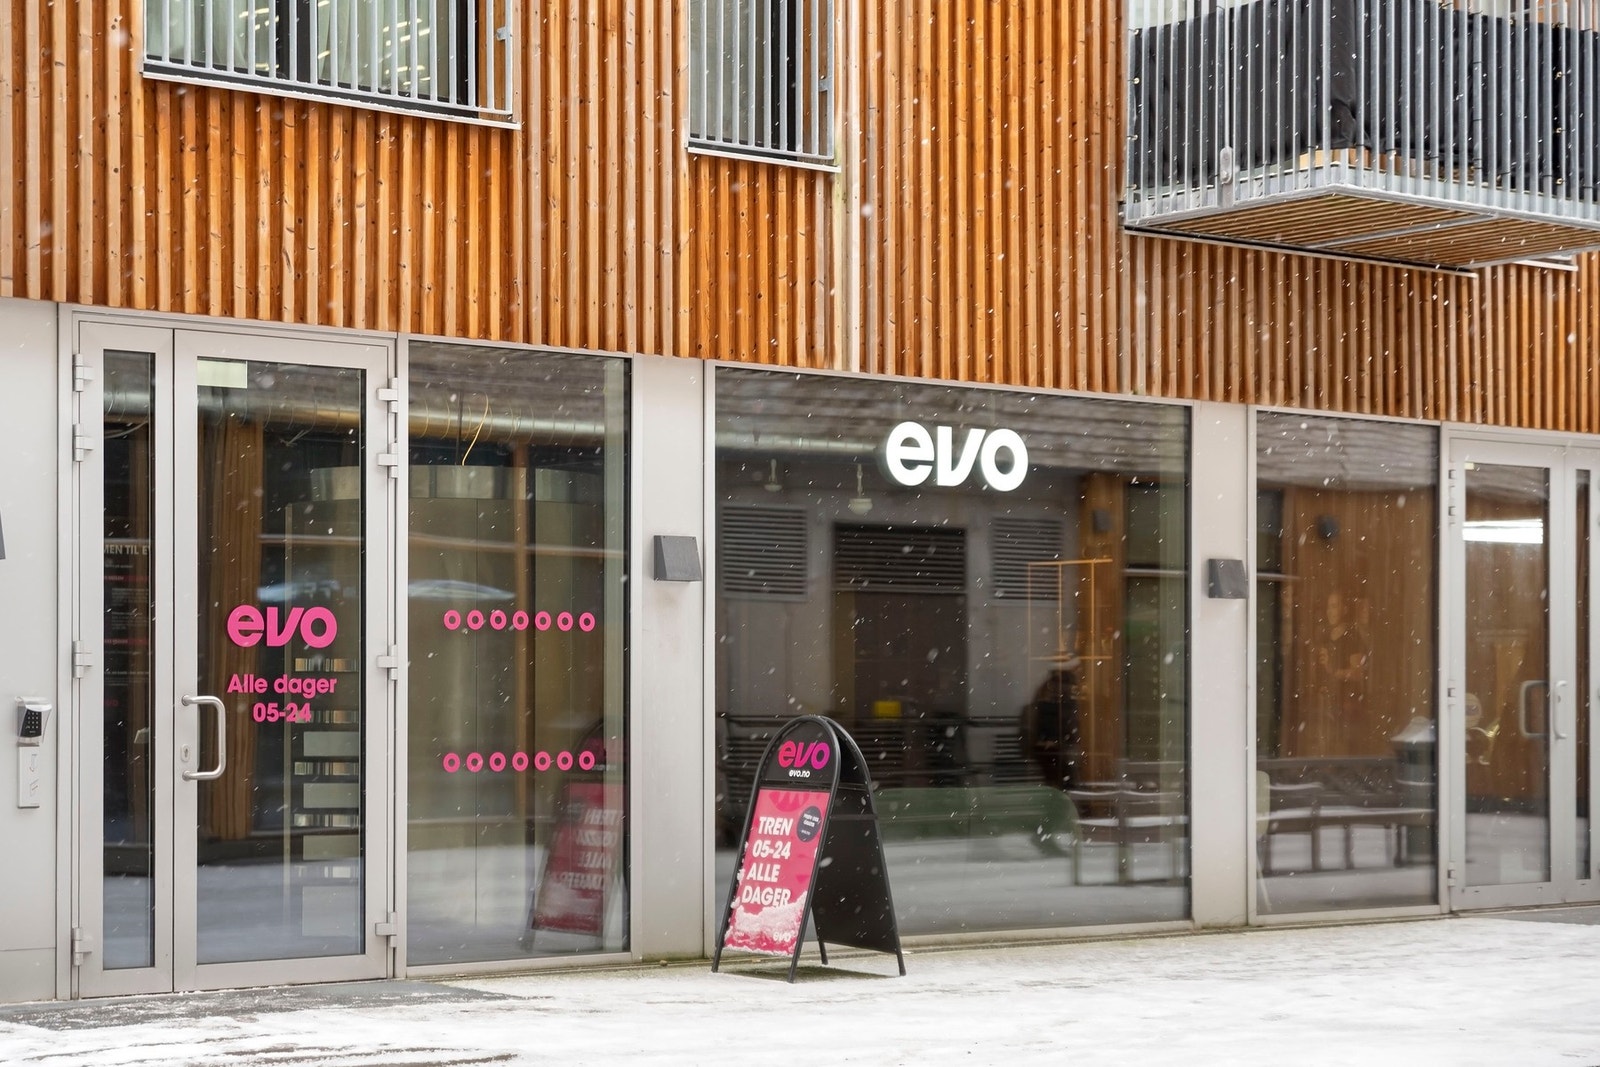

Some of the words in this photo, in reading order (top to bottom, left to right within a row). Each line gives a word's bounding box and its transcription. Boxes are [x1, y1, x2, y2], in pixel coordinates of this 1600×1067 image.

[886, 422, 1028, 492] evo
[125, 545, 139, 555] TIL
[227, 605, 338, 648] evo
[227, 674, 268, 694] Alle
[274, 674, 337, 700] dager
[253, 703, 312, 723] 05-24
[778, 740, 831, 770] evo
[788, 769, 811, 778] evo.no
[758, 816, 793, 836] TREN
[752, 840, 791, 860] 05-24
[746, 863, 780, 883] ALLE
[741, 885, 792, 908] DAGER
